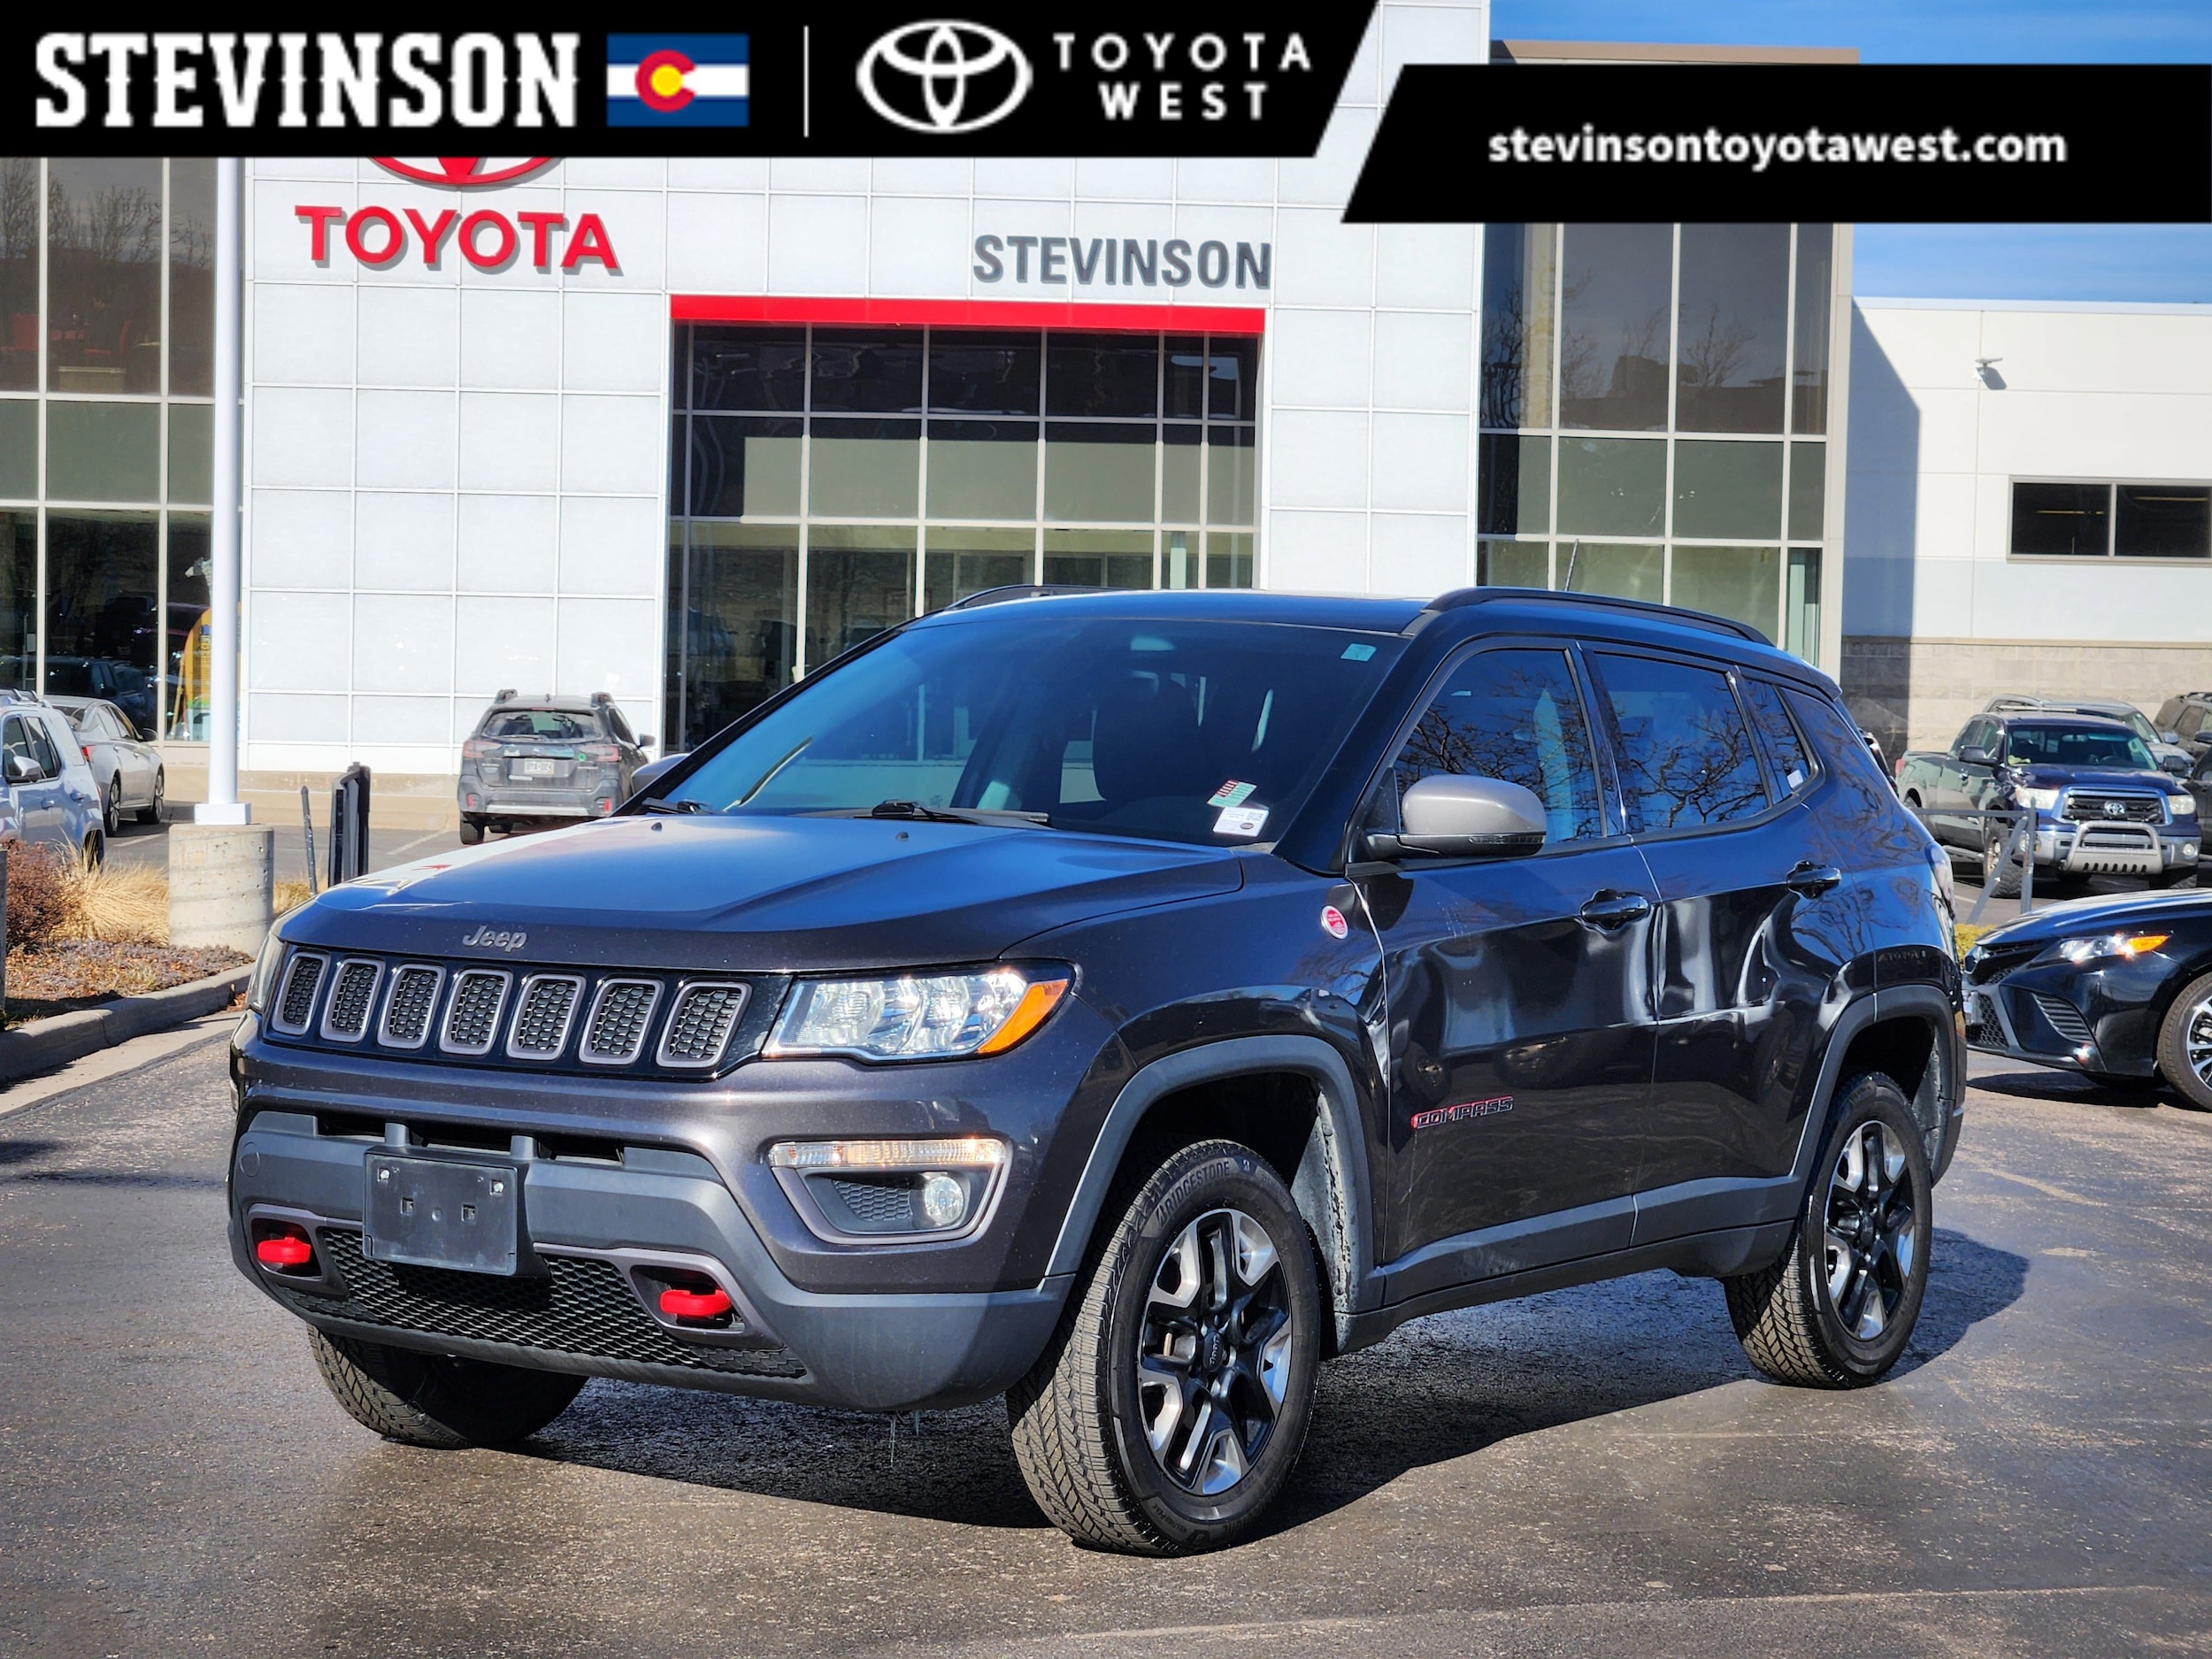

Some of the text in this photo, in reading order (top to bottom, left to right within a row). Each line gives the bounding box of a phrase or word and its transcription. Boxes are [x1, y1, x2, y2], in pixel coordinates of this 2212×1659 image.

[295, 205, 619, 270] TOYOTA
[972, 234, 1271, 289] STEVINSON
[462, 924, 527, 953] Jeep
[1410, 1094, 1514, 1130] COMPASS
[1155, 1159, 1231, 1227] BRIDGESTONE
